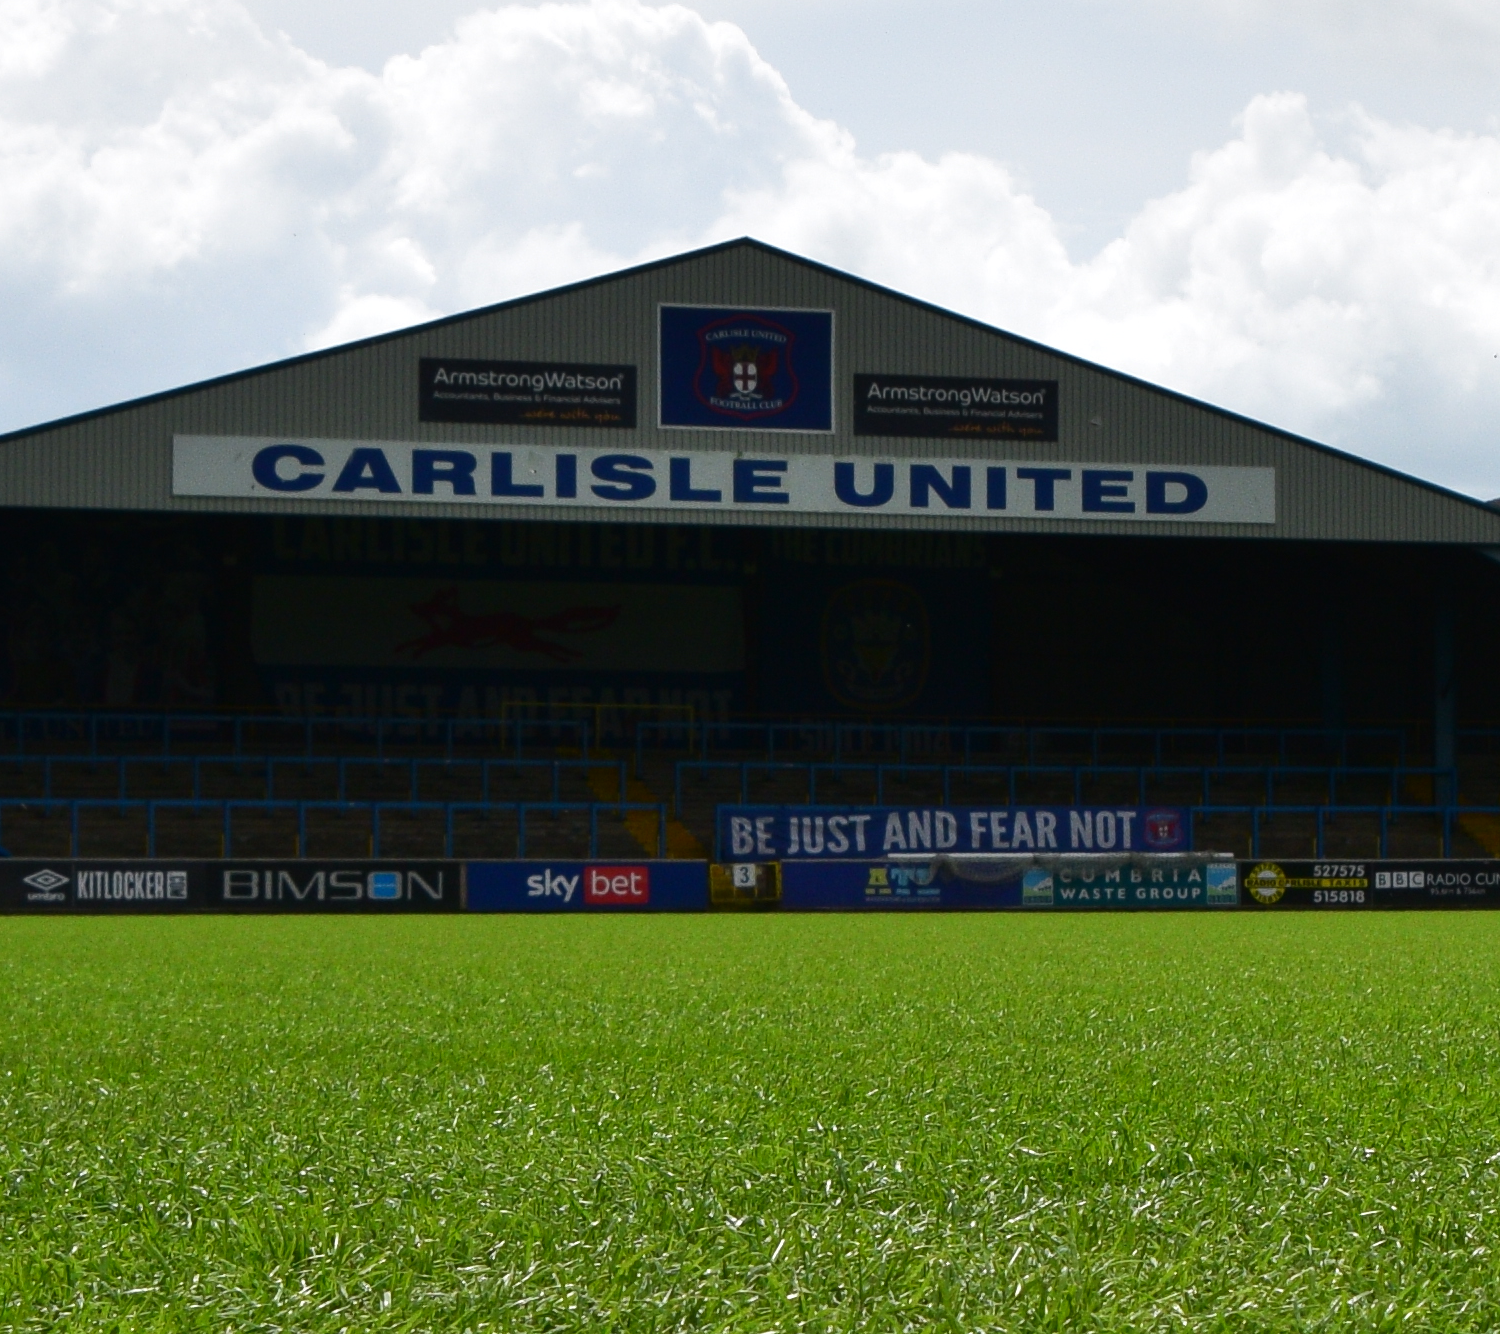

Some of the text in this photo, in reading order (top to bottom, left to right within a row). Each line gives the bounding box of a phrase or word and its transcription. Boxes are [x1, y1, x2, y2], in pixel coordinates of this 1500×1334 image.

[706, 329, 787, 344] CARLISLE UNITED
[710, 397, 783, 410] FOOTBALL CLUB
[252, 445, 1209, 514] CARLISLE UNITED
[731, 810, 1137, 855] BE JUST AND FEAR NOT
[740, 866, 751, 884] 3
[1060, 867, 1202, 884] CUMBRIA
[1313, 865, 1365, 878] 527575
[1377, 872, 1423, 887] BBC
[1426, 872, 1471, 886] RADIO
[77, 870, 165, 900] KITLOCKER
[223, 870, 443, 900] BIMSON
[527, 868, 643, 903] sky bet
[1247, 878, 1277, 887] RADIO
[1329, 878, 1366, 887] TAXIS
[1060, 887, 1202, 901] WASTE GROUP
[1313, 890, 1365, 903] 515818
